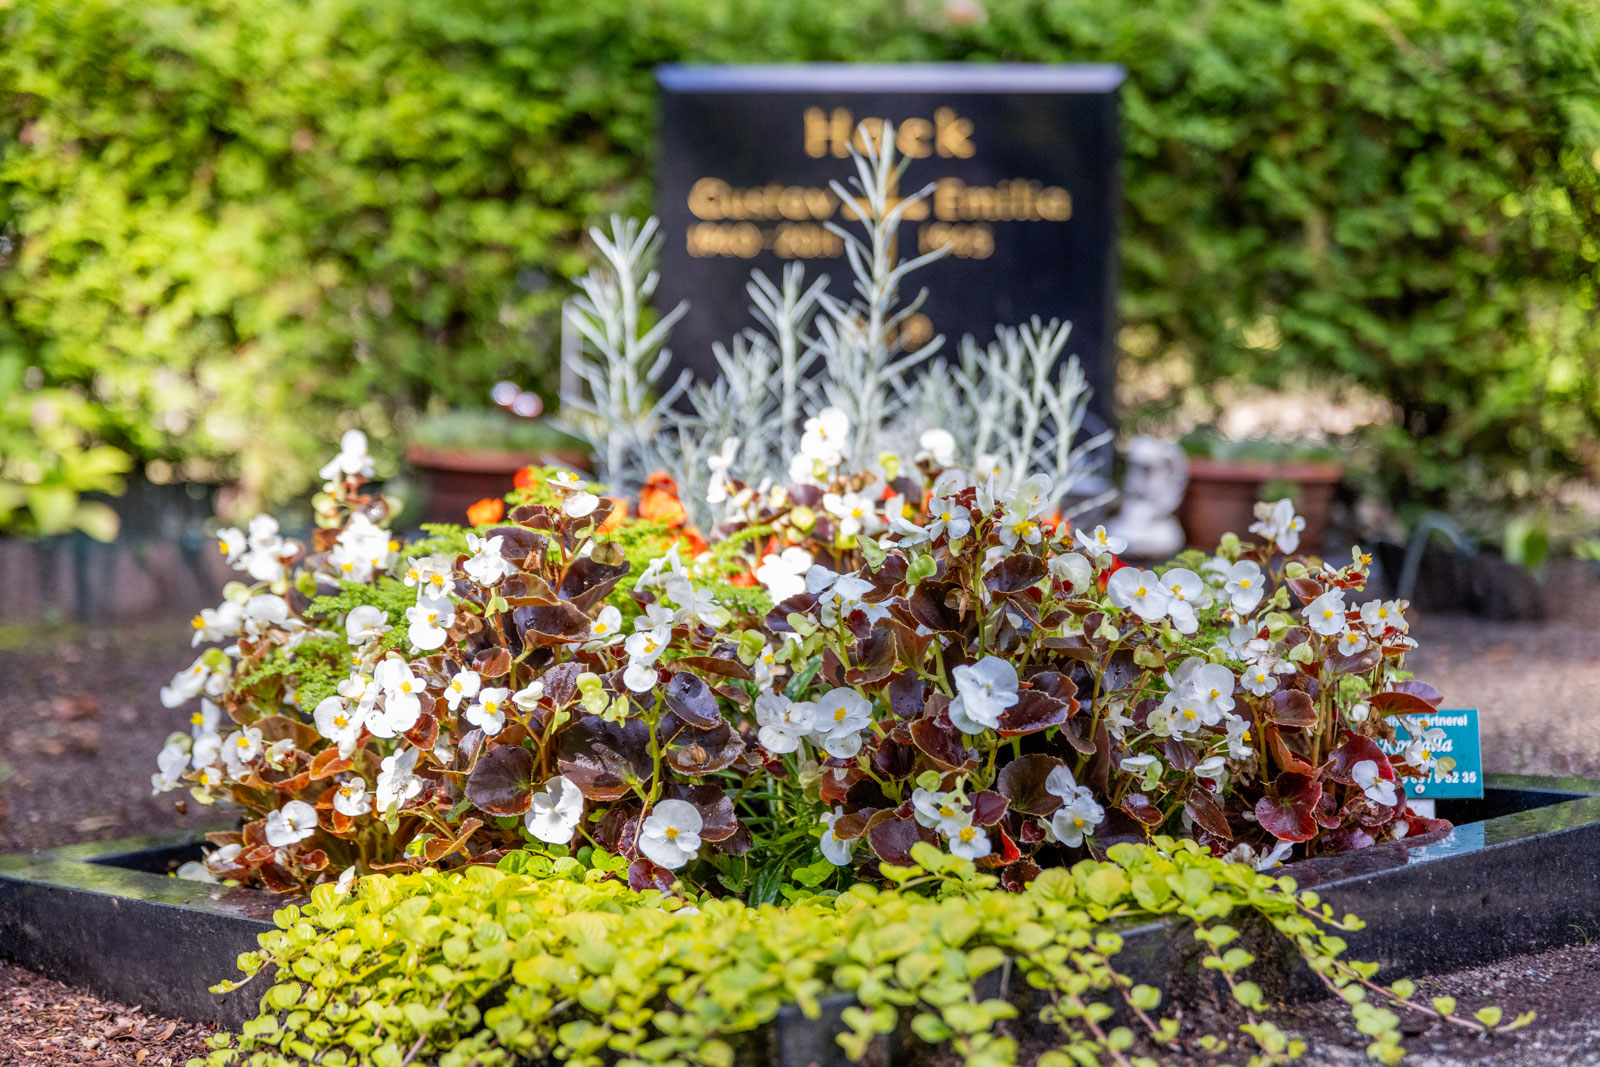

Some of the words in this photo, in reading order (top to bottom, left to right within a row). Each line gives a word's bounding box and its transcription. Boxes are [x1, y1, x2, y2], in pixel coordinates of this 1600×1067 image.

[804, 107, 976, 158] Hack
[688, 177, 838, 220] Gustav
[1462, 771, 1477, 784] 35
